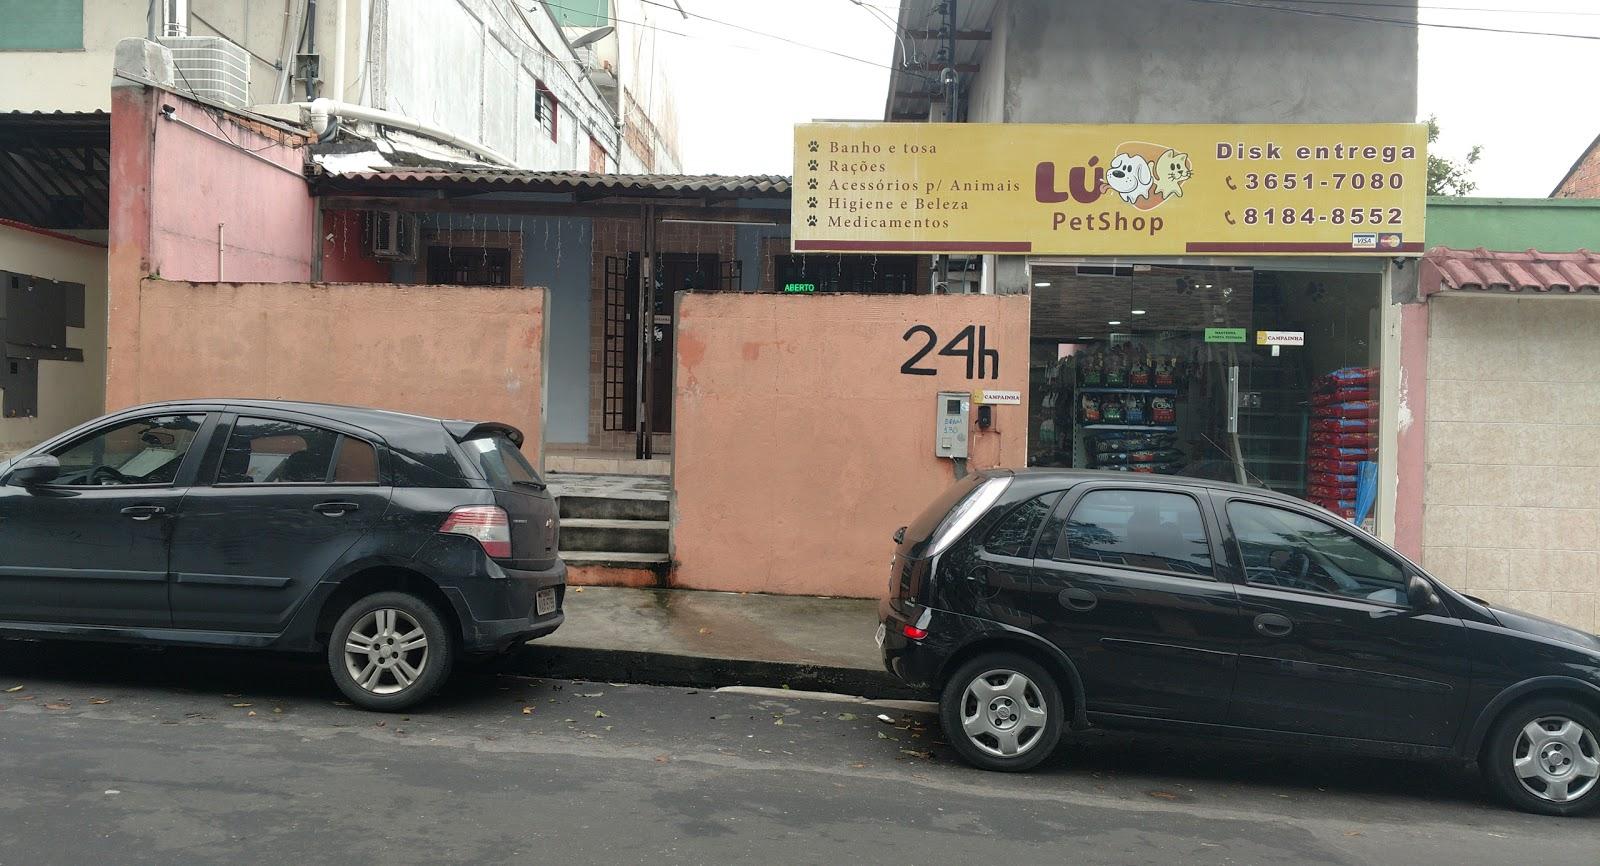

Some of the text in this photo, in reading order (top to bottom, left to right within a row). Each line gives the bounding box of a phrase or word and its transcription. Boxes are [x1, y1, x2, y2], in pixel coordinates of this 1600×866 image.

[829, 141, 937, 154] Banho e tosa
[1215, 142, 1417, 163] Disk entrega
[828, 160, 887, 174] Rações
[828, 178, 1021, 194] Acessórios p/ Animais
[1035, 156, 1104, 204] LÚ
[1245, 172, 1404, 190] 3651-7080
[828, 197, 969, 212] Higiene e Beleza
[828, 215, 949, 229] Medicamentos
[1053, 211, 1164, 235] PetShop
[1243, 207, 1403, 226] 8184-8552
[784, 283, 815, 292] ABERTO
[900, 324, 999, 380] 24h
